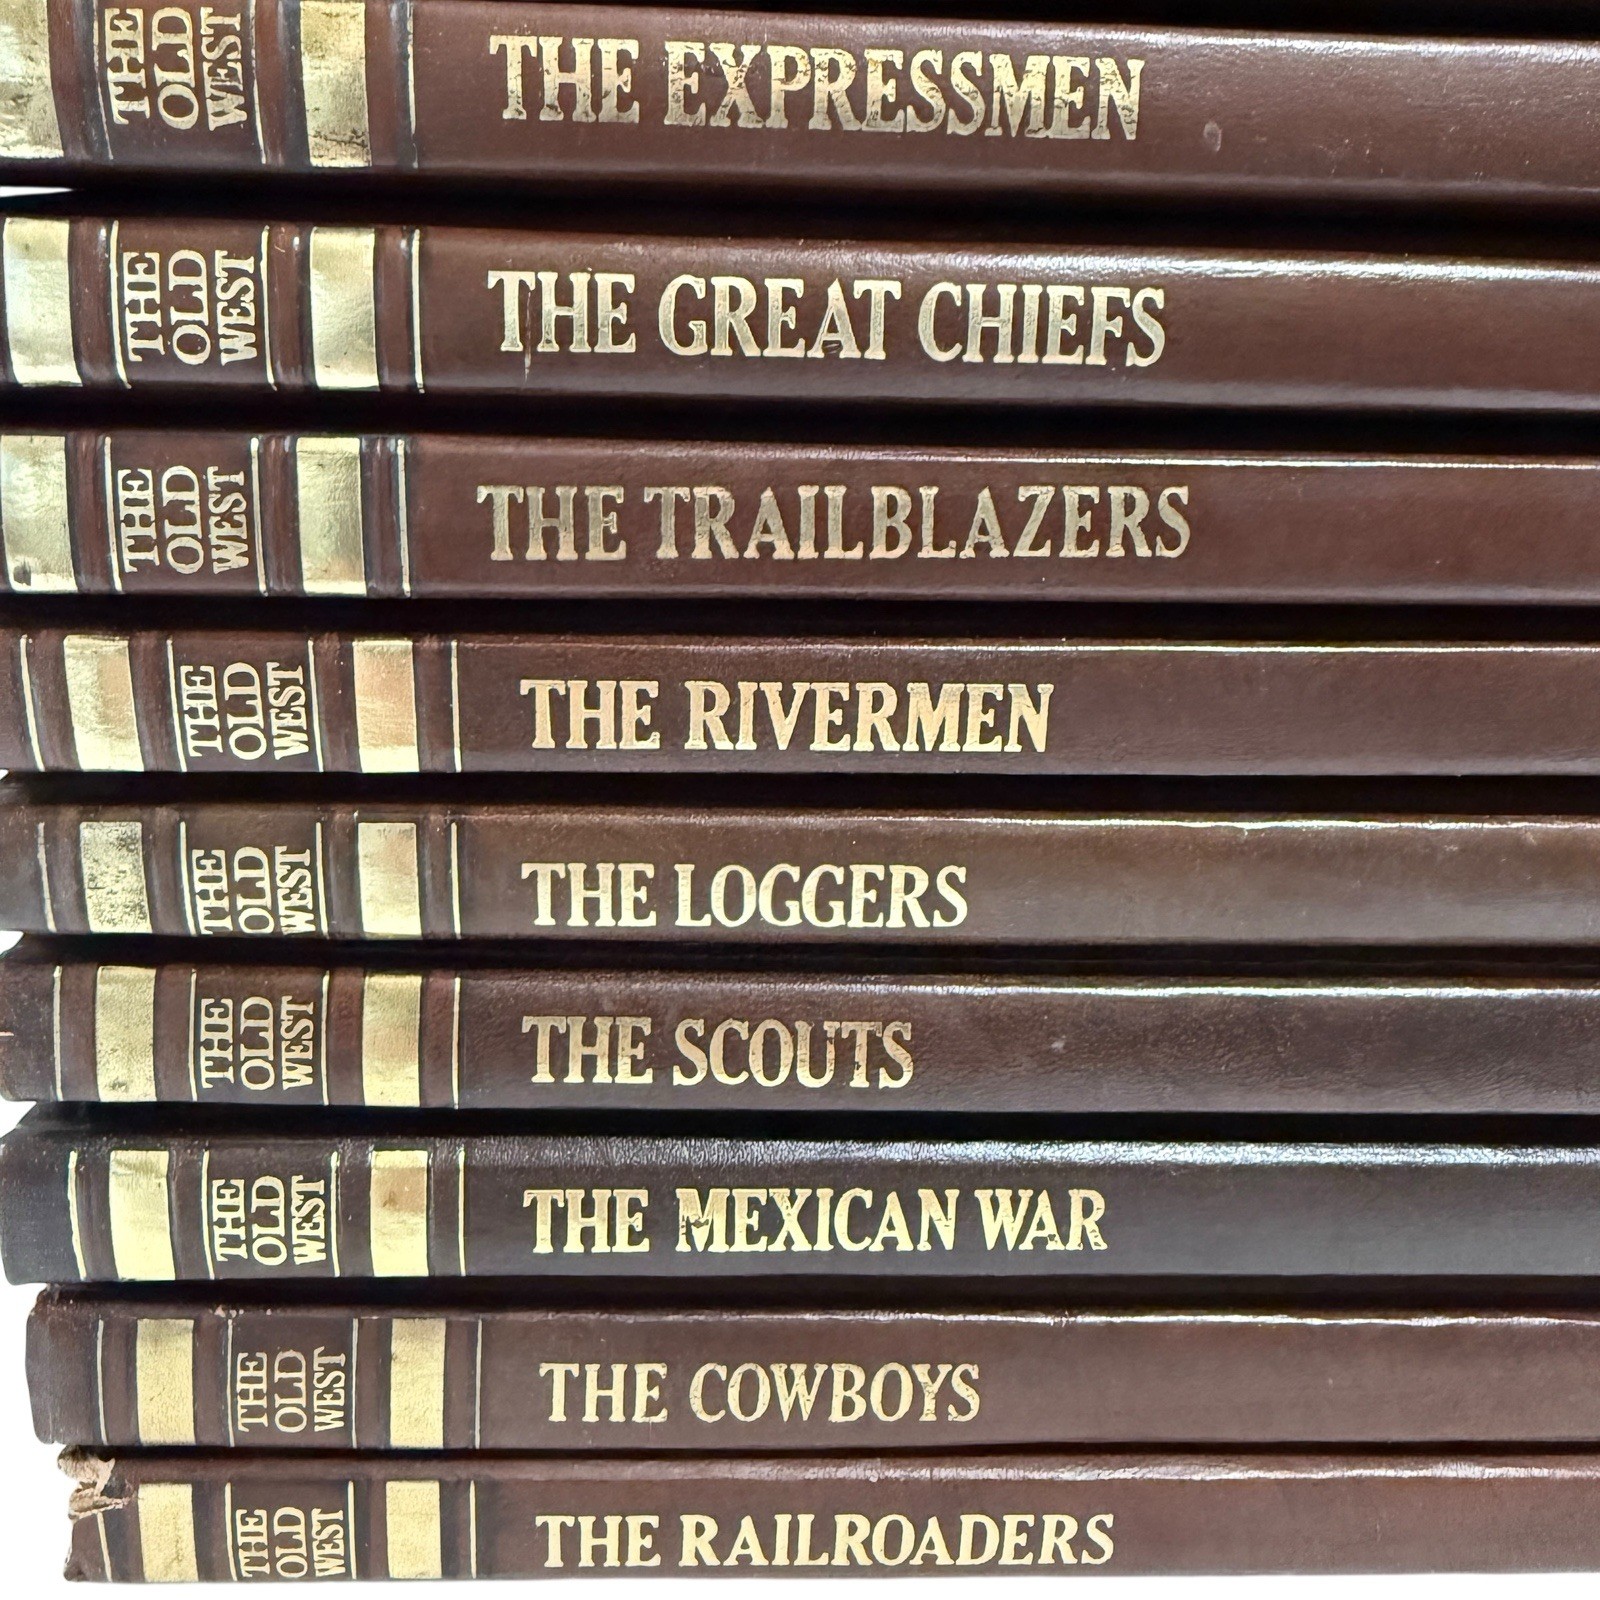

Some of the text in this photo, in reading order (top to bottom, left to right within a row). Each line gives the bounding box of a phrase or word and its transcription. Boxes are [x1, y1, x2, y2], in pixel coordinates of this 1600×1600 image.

[105, 8, 150, 124] THE
[152, 7, 198, 129] OLD
[200, 7, 247, 131] WEST
[489, 35, 1145, 141] THE EXPRESSMEN
[123, 252, 165, 361] THE
[168, 250, 210, 365] OLD
[215, 250, 257, 365] WEST
[488, 271, 1165, 367] THE GREAT CHIEFS
[116, 469, 159, 575] THE
[162, 466, 204, 574] OLD
[207, 466, 249, 574] WEST
[477, 485, 1190, 561] THE TRAILBLAZERS
[178, 666, 223, 759] THE
[223, 663, 267, 760] OLD
[267, 660, 312, 760] WEST
[520, 680, 1054, 752] THE RIVERMEN
[190, 850, 233, 934] THE
[234, 847, 277, 933] OLD
[275, 846, 315, 934] WEST
[522, 863, 967, 928] THE LOGGERS
[200, 999, 234, 1088] THE
[240, 997, 275, 1090] OLD
[280, 996, 313, 1090] WEST
[522, 1016, 913, 1089] THE SCOUTS
[212, 1179, 248, 1261] THE
[251, 1176, 287, 1265] OLD
[291, 1175, 326, 1265] WEST
[523, 1188, 1107, 1254] THE MEXICAN WAR
[236, 1353, 268, 1432] THE
[274, 1350, 307, 1433] OLD
[313, 1346, 345, 1432] WEST
[539, 1363, 979, 1424] THE COWBOYS
[236, 1510, 270, 1577] THE
[274, 1507, 307, 1578] OLD
[312, 1508, 345, 1577] WEST
[536, 1514, 1113, 1567] THE RAILROADERS
